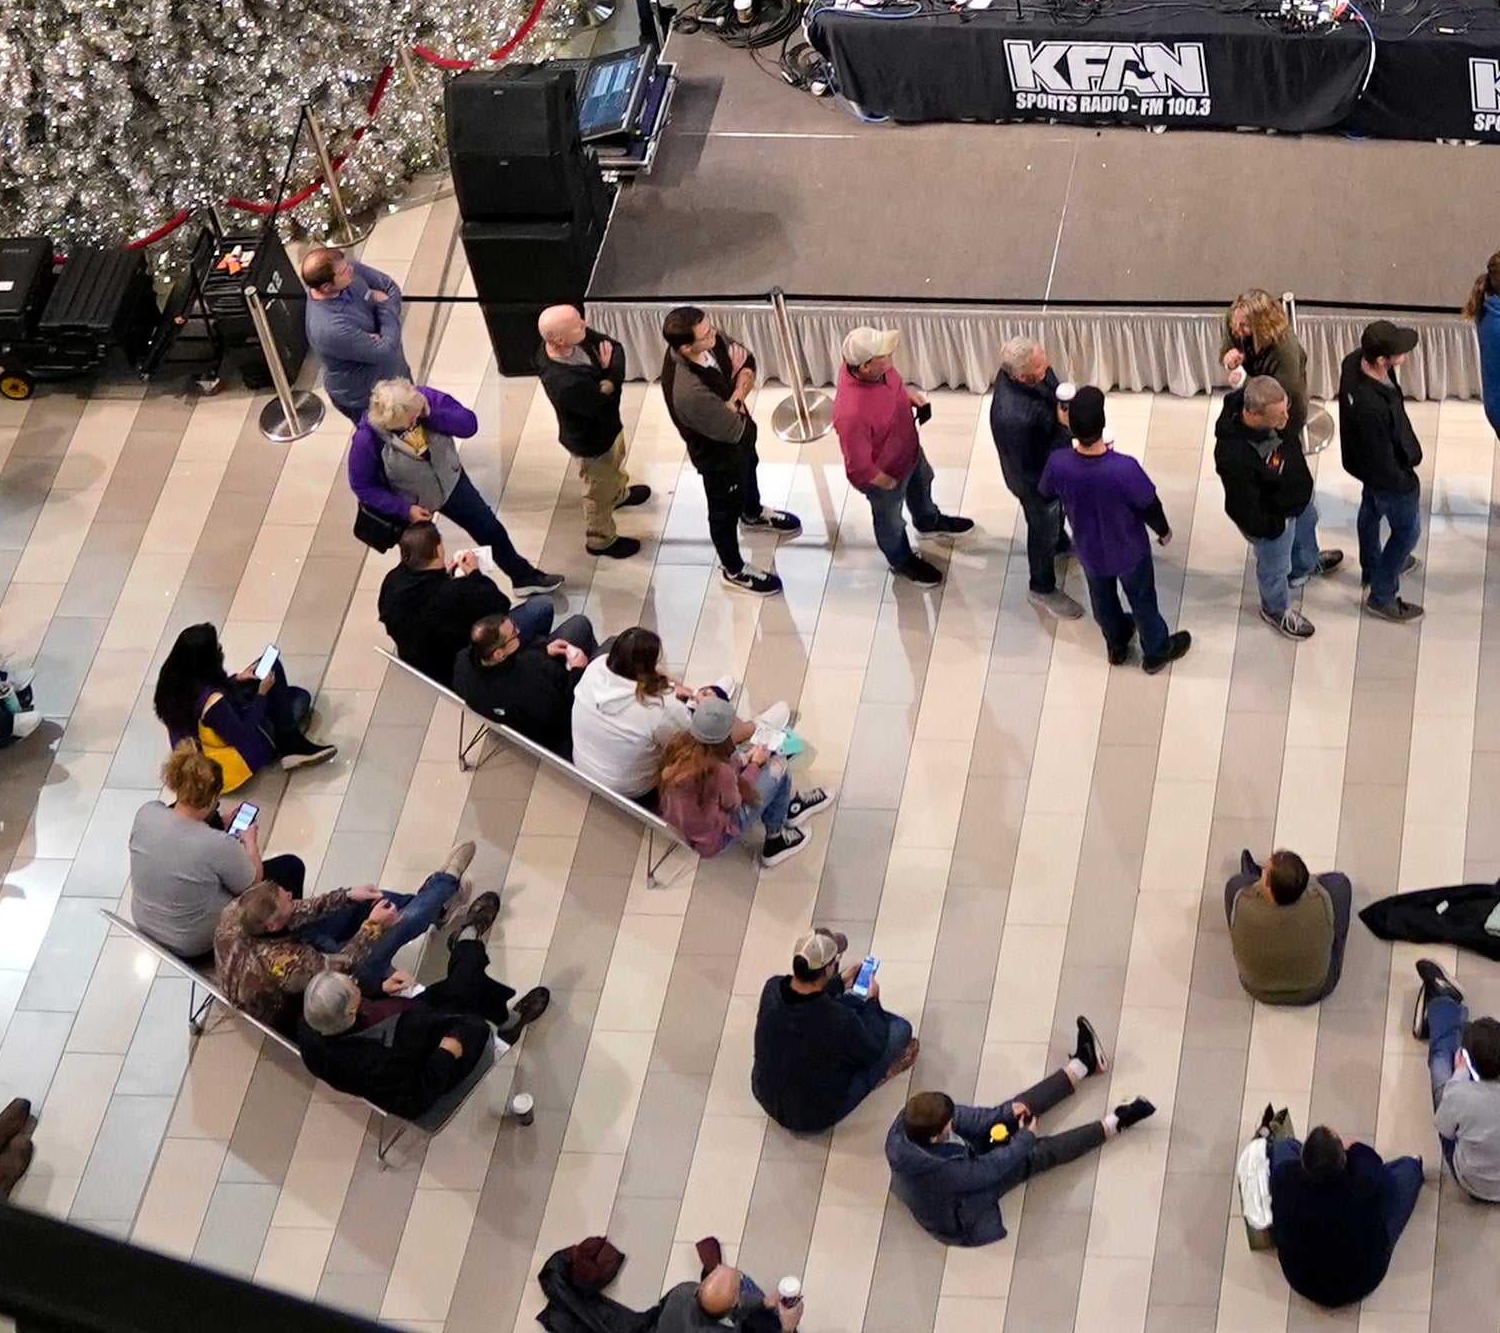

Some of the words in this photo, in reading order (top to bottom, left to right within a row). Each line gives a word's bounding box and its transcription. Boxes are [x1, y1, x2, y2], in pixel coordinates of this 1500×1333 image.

[1003, 39, 1210, 97] KFAN
[1016, 91, 1077, 113] SPORTS
[1080, 95, 1129, 113] RADIO
[1140, 97, 1164, 116] FM
[1167, 97, 1211, 117] 100.3
